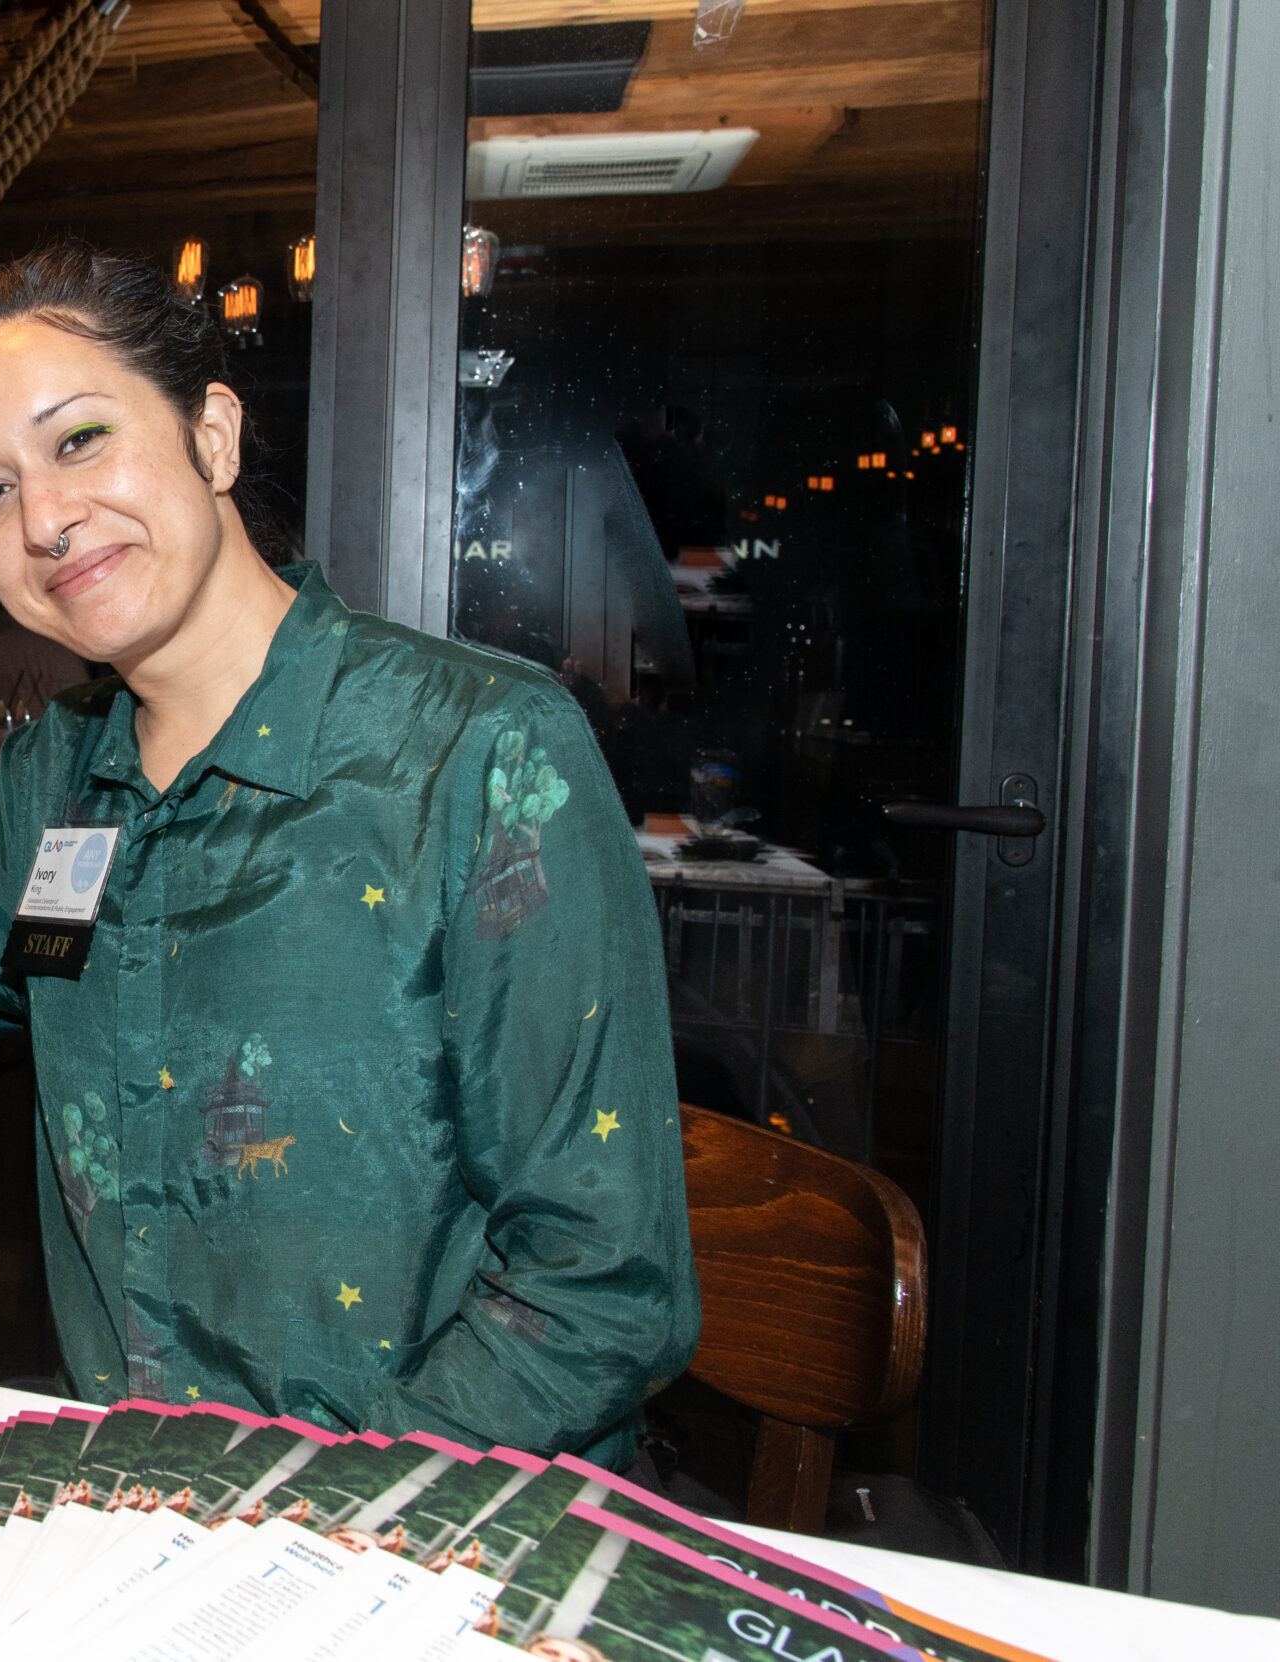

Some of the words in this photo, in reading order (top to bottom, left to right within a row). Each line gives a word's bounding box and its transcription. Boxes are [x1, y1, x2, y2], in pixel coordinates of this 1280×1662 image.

[44, 839, 64, 853] GLAD
[34, 867, 57, 884] Ivory
[30, 884, 42, 896] King
[24, 933, 73, 957] STAFF
